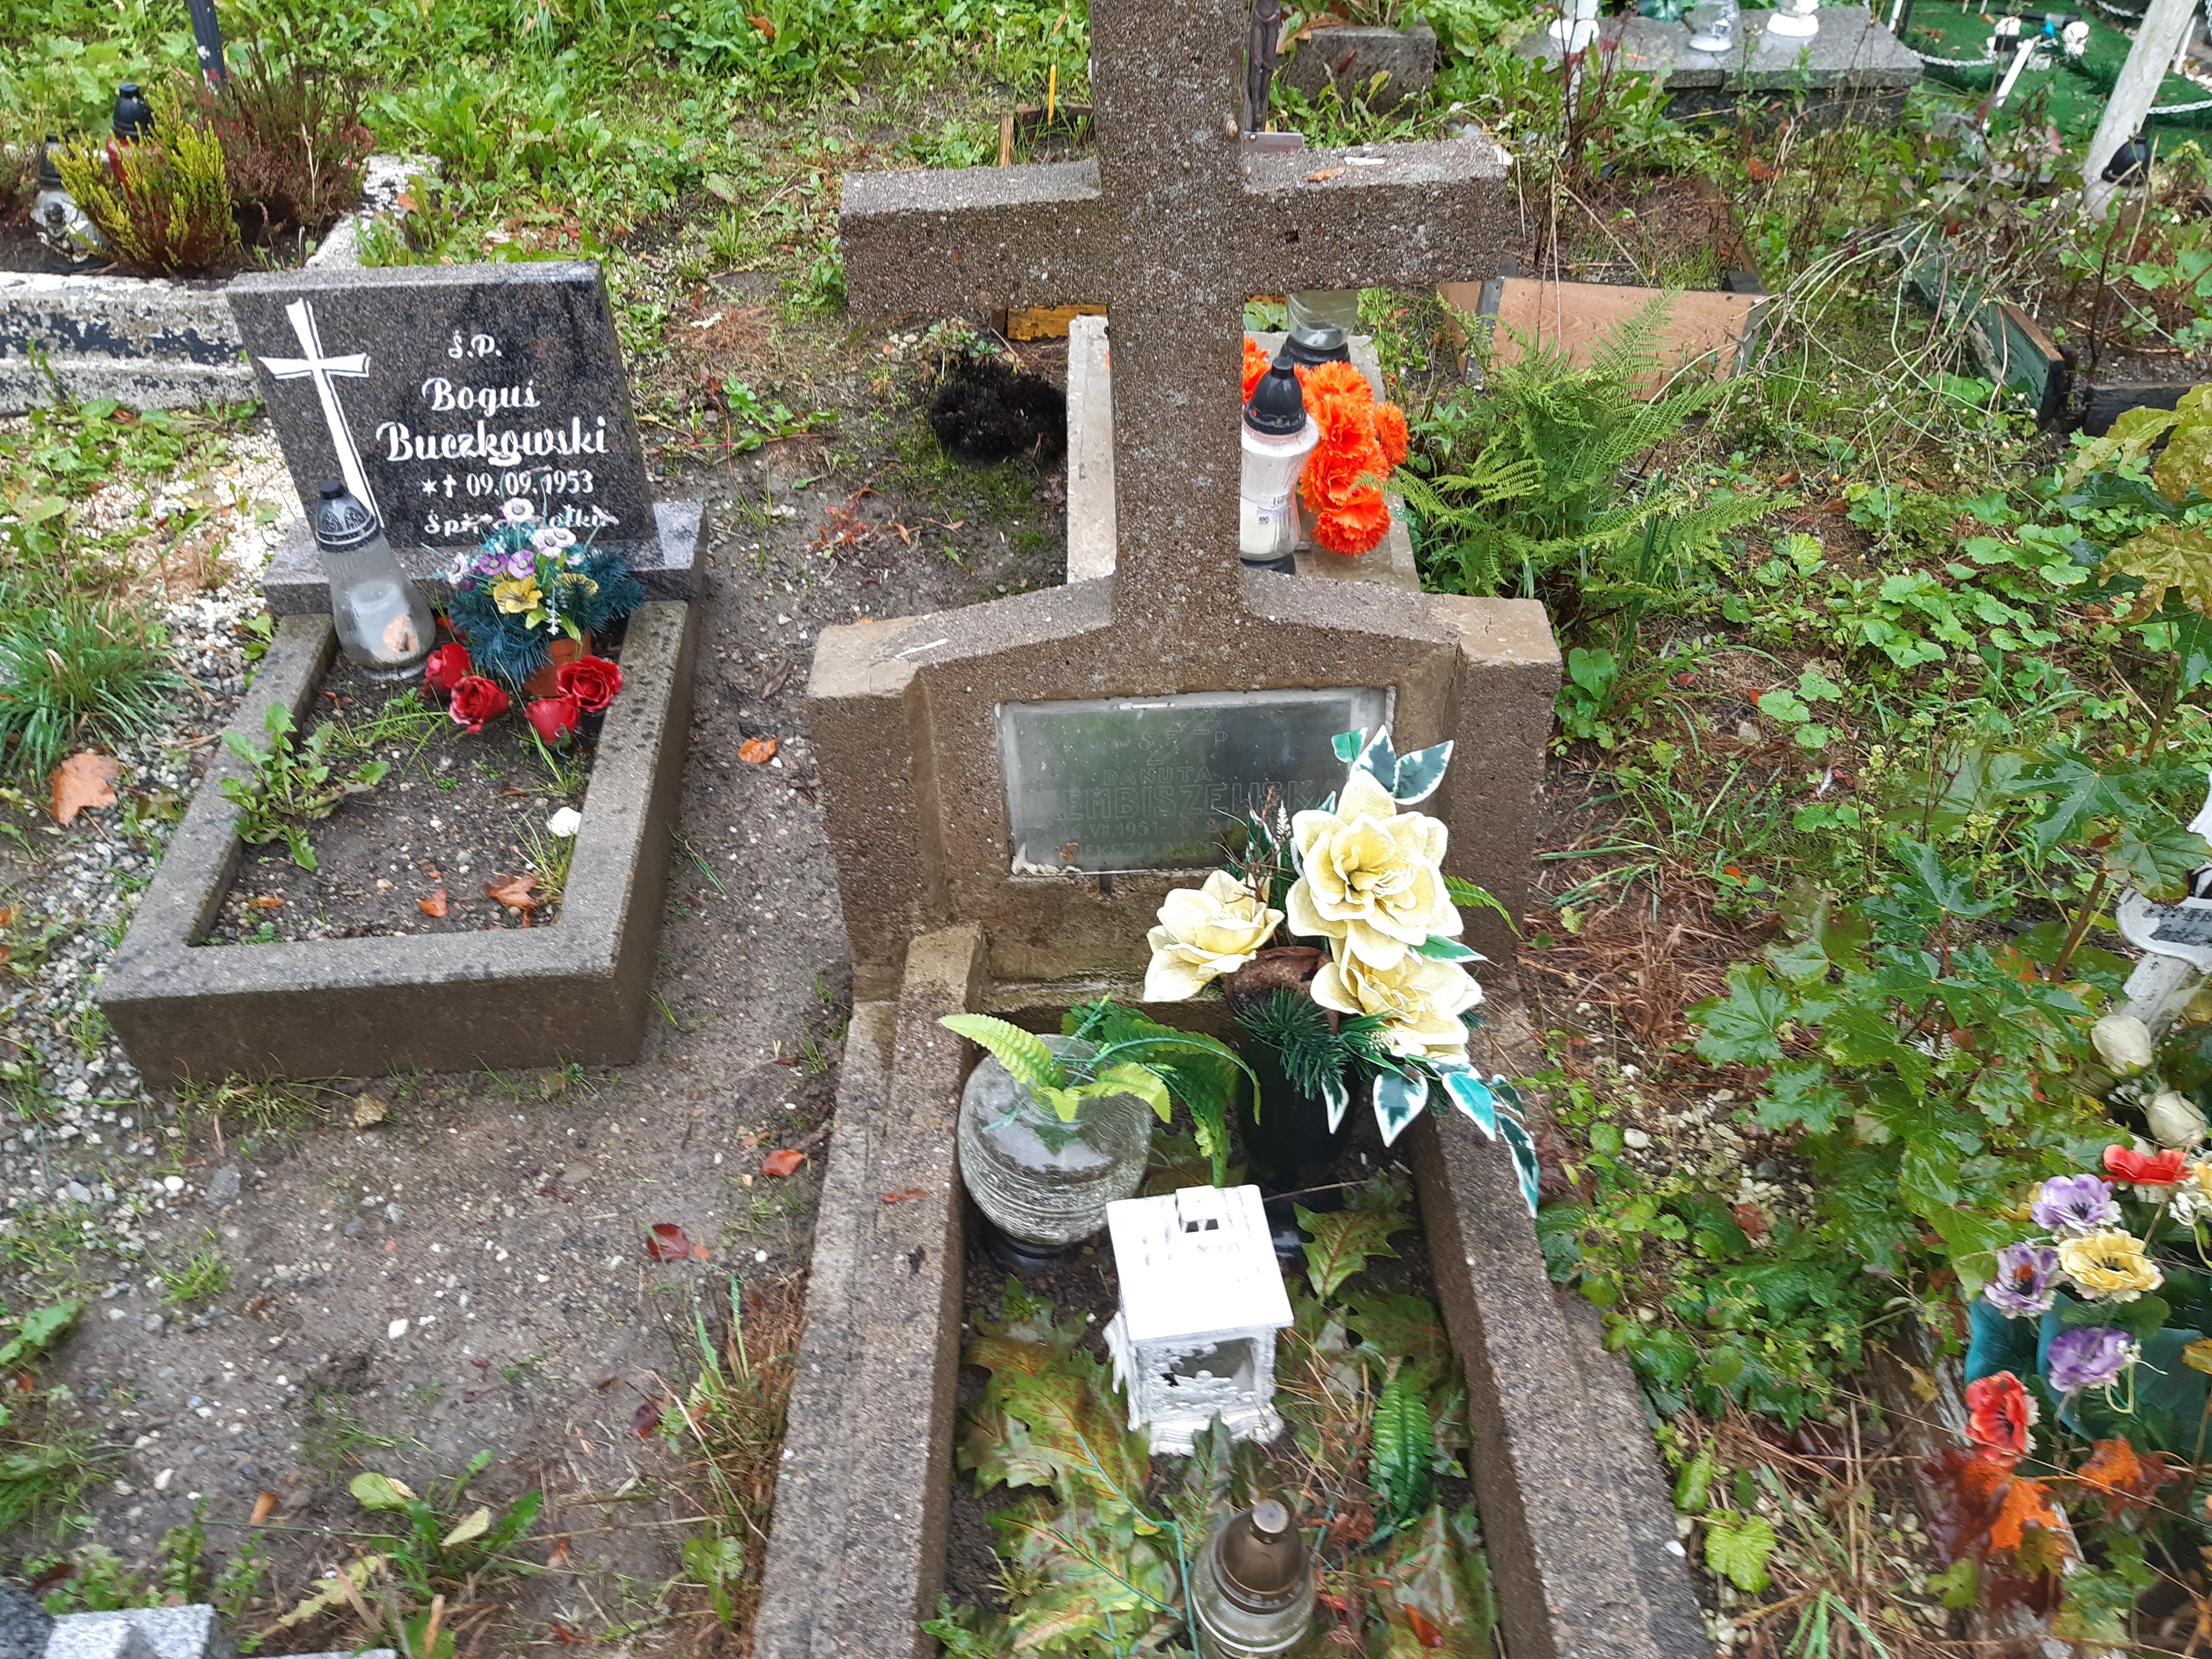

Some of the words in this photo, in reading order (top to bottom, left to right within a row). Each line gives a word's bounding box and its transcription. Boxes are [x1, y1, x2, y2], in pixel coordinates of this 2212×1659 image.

[421, 377, 541, 417] Boguś
[376, 416, 610, 462] Buczkowski
[1104, 766, 1214, 786] DANUTA
